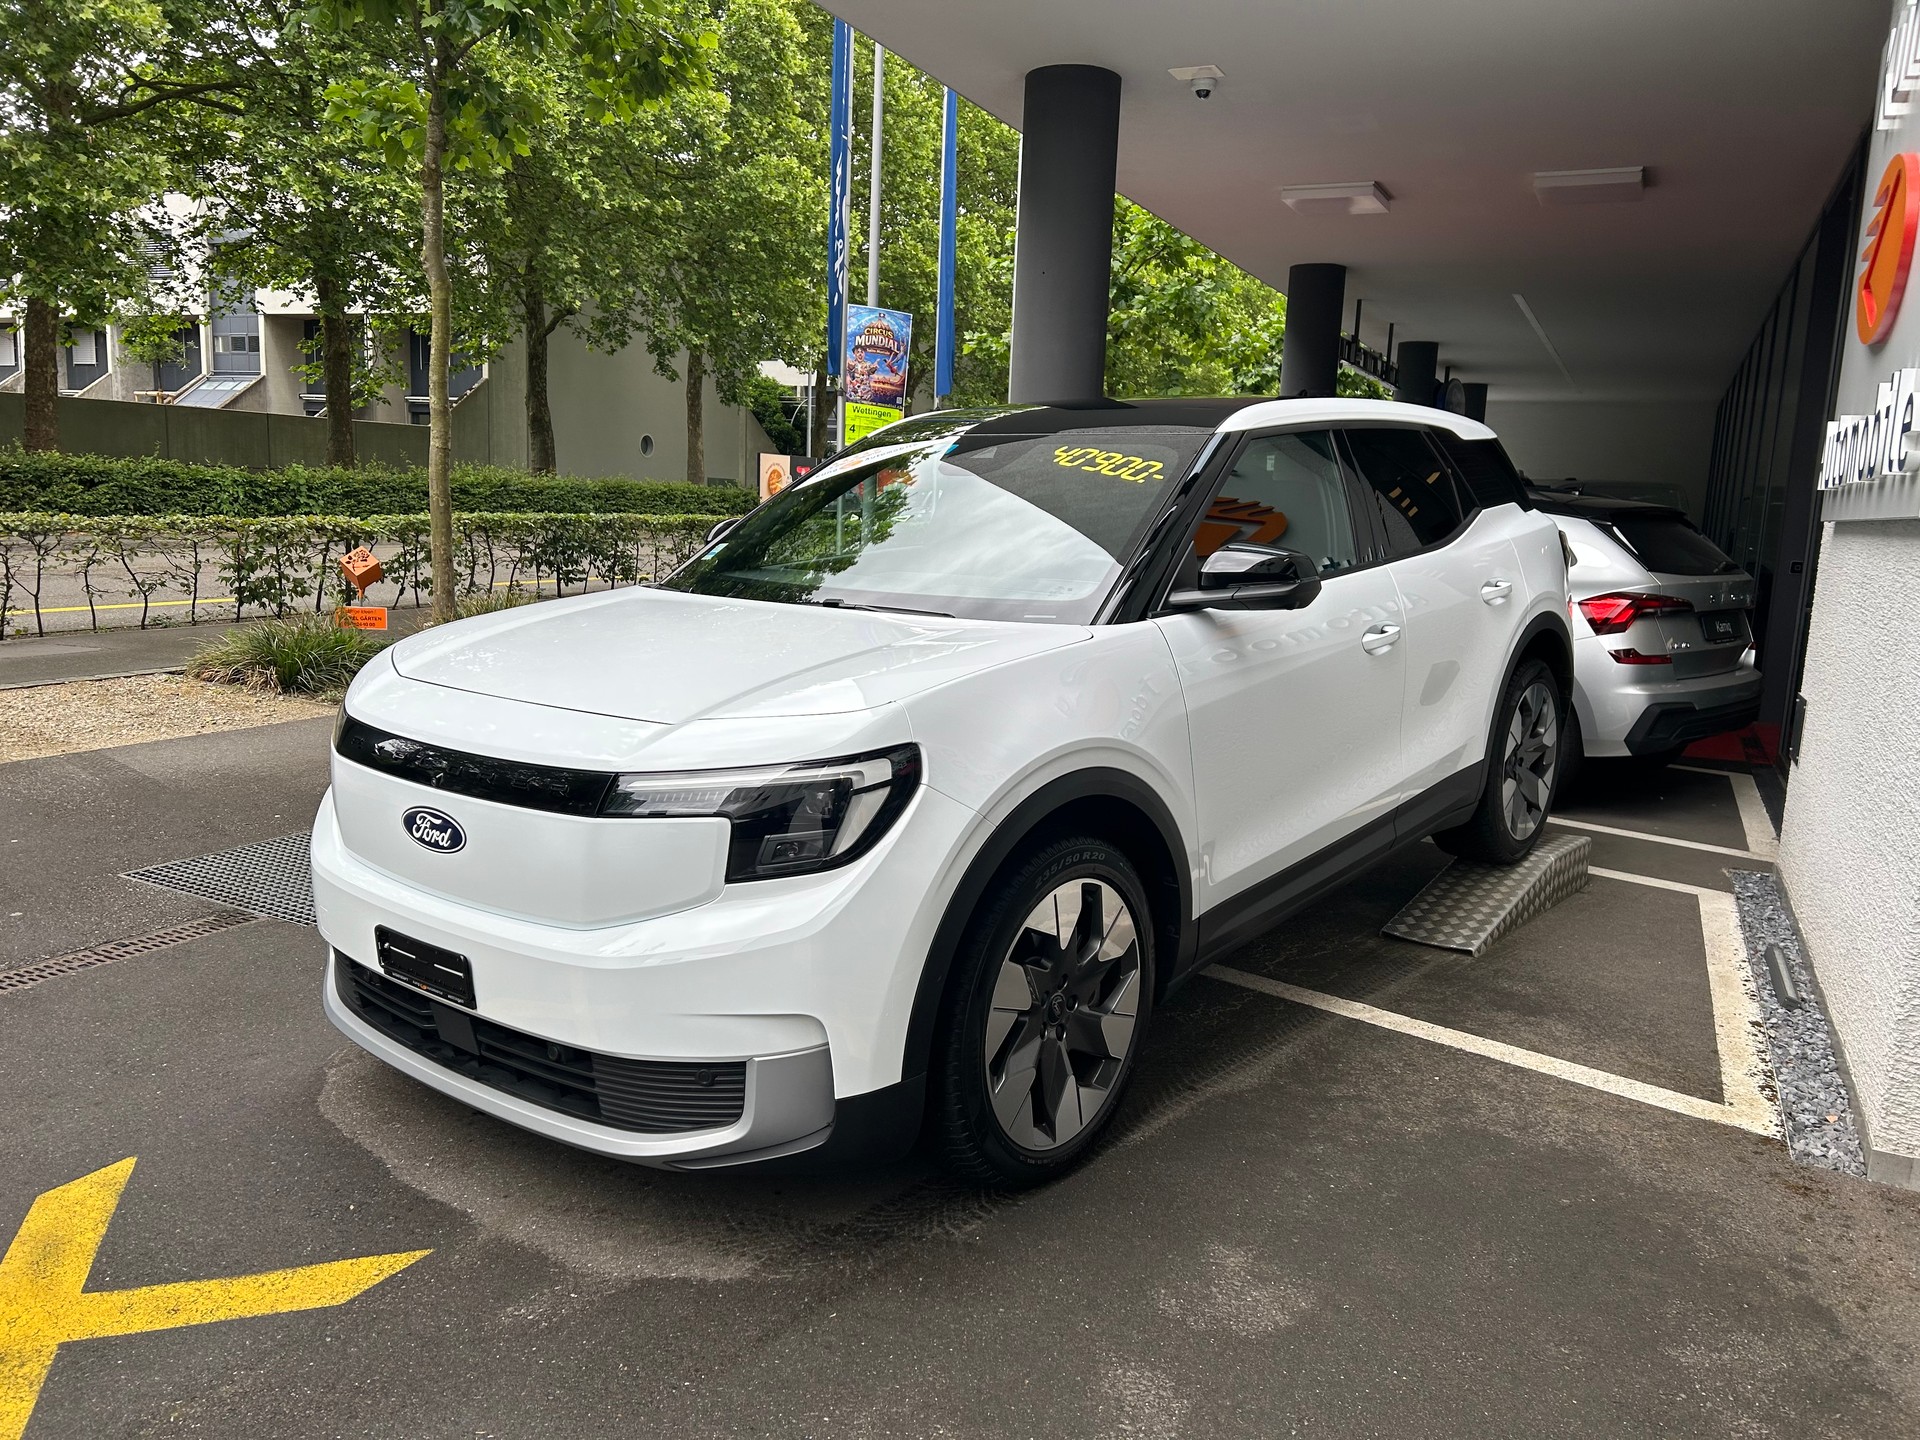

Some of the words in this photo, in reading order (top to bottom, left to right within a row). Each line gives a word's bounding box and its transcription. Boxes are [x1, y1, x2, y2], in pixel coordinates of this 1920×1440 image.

[864, 327, 894, 339] CIRCUS
[855, 335, 900, 354] MUNDIAL
[852, 405, 892, 418] Wettingen
[849, 424, 856, 434] 4
[412, 812, 452, 848] Ford
[1034, 852, 1080, 889] 235/50
[1081, 850, 1106, 861] R20
